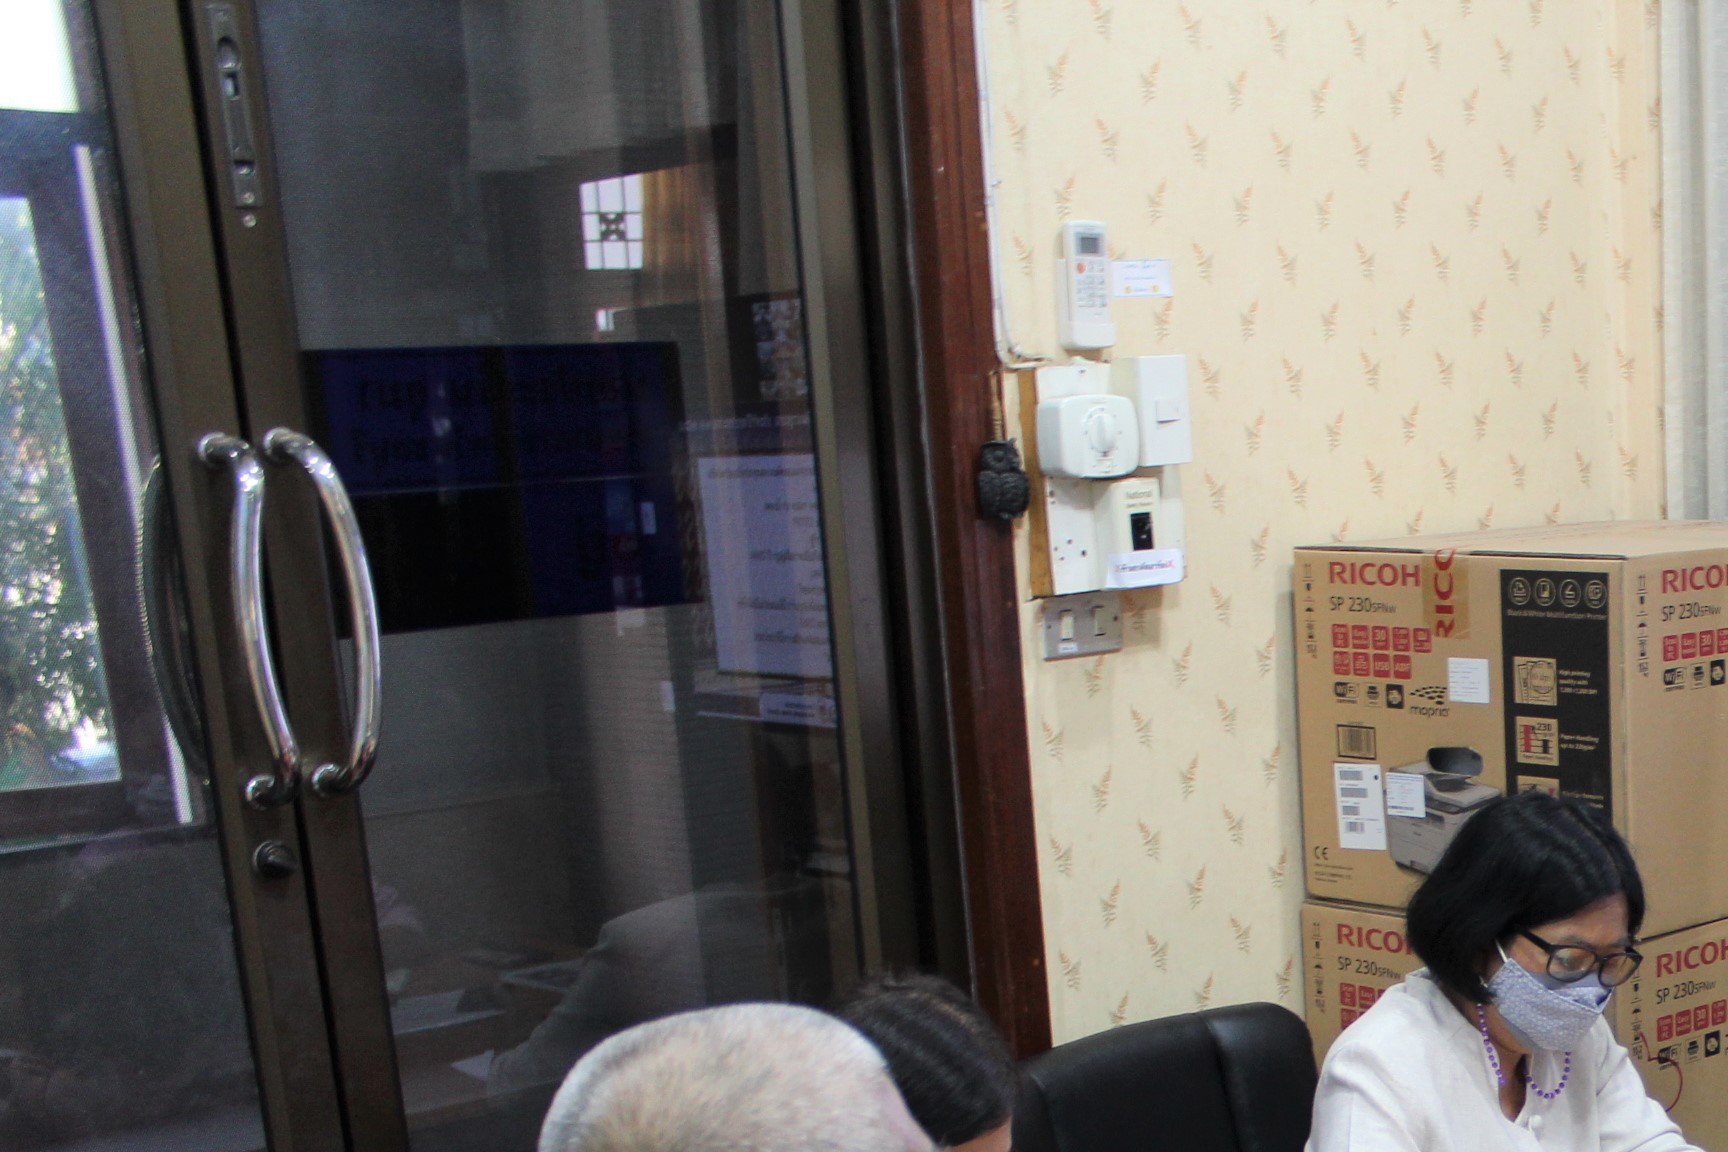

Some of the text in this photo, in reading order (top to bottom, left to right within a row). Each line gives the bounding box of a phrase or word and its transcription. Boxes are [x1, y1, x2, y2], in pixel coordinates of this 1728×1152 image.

[1329, 561, 1421, 587] RICOH
[1330, 596, 1345, 611] SP
[1662, 605, 1676, 622] SP
[1337, 956, 1352, 971] SP
[1656, 988, 1670, 1005] SP
